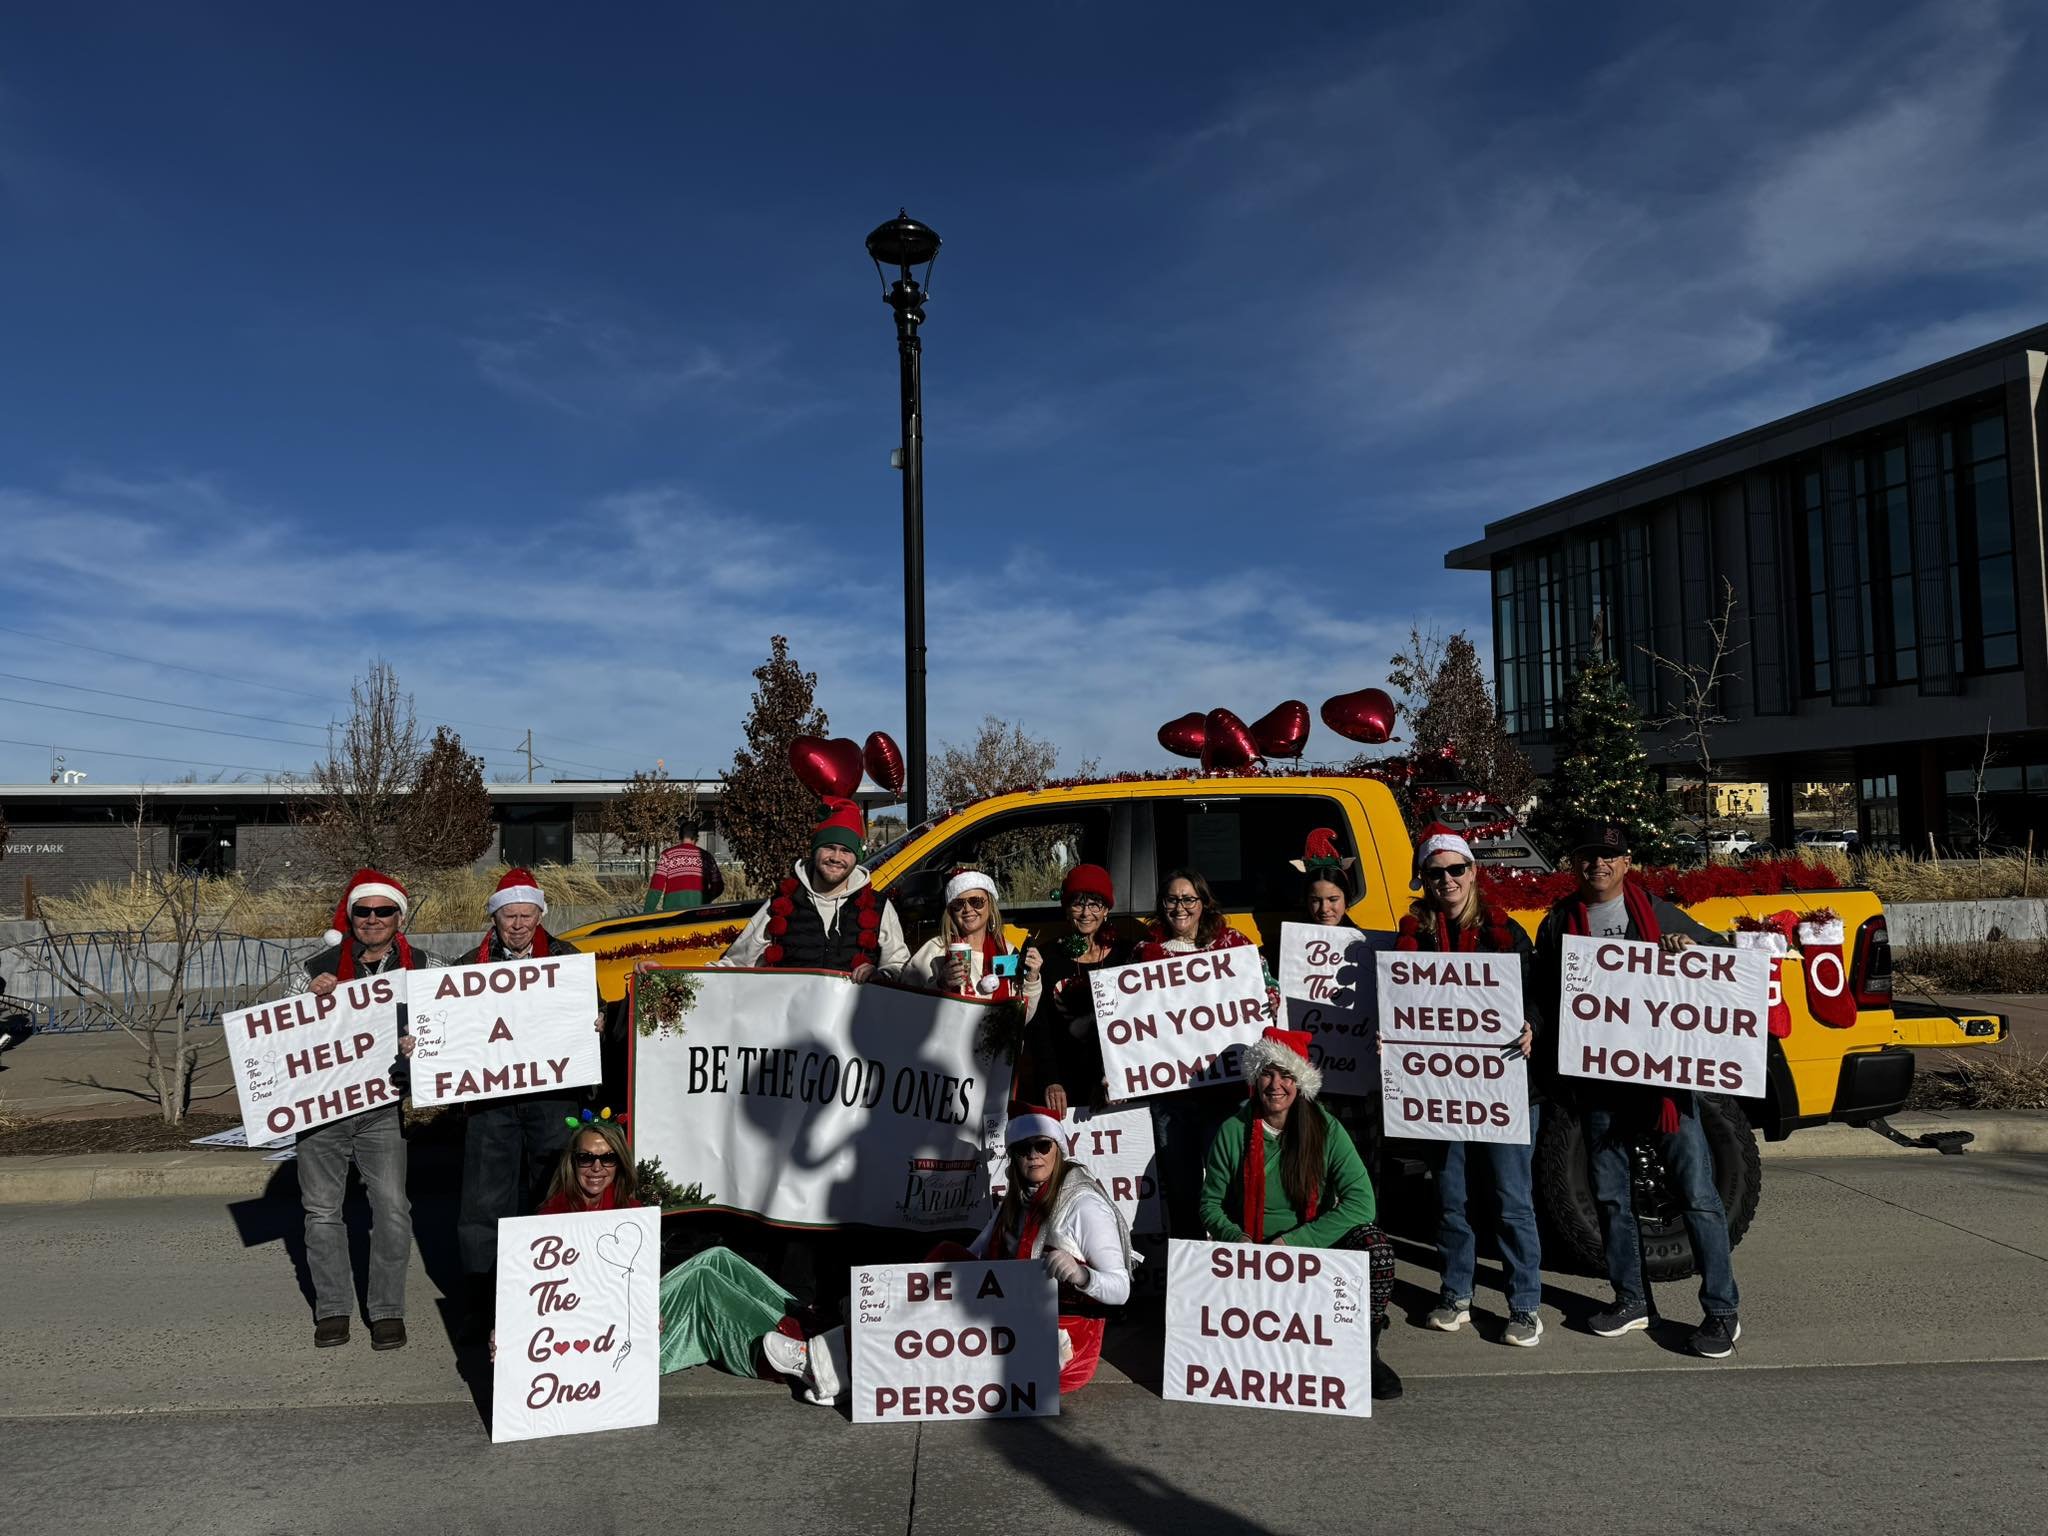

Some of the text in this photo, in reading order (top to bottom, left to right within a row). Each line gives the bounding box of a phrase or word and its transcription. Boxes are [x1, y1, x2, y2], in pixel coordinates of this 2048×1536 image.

[36, 843, 64, 853] PARK
[1305, 940, 1343, 966] Be
[1596, 944, 1737, 982] CHECK
[435, 963, 561, 1000] ADOPT
[1117, 953, 1236, 994] CHECK
[1303, 974, 1342, 1001] The
[1391, 961, 1500, 987] SMALL
[245, 978, 394, 1039] HELP US
[416, 1014, 430, 1024] Be
[1107, 998, 1265, 1045] ON YOUR
[1394, 1006, 1502, 1033] NEEDS
[1571, 993, 1758, 1038] ON YOUR
[416, 1025, 431, 1036] The
[488, 1017, 514, 1043] A
[244, 1058, 259, 1068] Be
[285, 1032, 375, 1079] HELP
[417, 1048, 438, 1059] Ones
[1402, 1052, 1505, 1080] GOOD
[1582, 1045, 1743, 1090] HOMIES
[246, 1068, 262, 1080] The
[435, 1057, 570, 1098] FAMILY
[687, 1045, 974, 1125] BE THE GOOD ONES
[1125, 1050, 1246, 1093] HOMIE
[251, 1091, 272, 1102] Ones
[1403, 1097, 1510, 1127] DEEDS
[1091, 1129, 1122, 1155] IT
[918, 1160, 944, 1169] PARK
[530, 1235, 580, 1271] Be
[1211, 1247, 1321, 1283] SHOP
[859, 1272, 874, 1284] Be
[859, 1285, 875, 1297] The
[907, 1269, 1005, 1302] BE A
[1333, 1276, 1347, 1287] Be
[529, 1277, 580, 1316] The
[1333, 1288, 1347, 1299] The
[859, 1312, 881, 1323] Ones
[1201, 1305, 1333, 1346] LOCAL
[1333, 1313, 1353, 1324] Ones
[894, 1326, 1016, 1359] GOOD
[526, 1372, 601, 1410] Ones
[875, 1382, 1036, 1416] PERSON
[1186, 1364, 1347, 1410] PARKER
